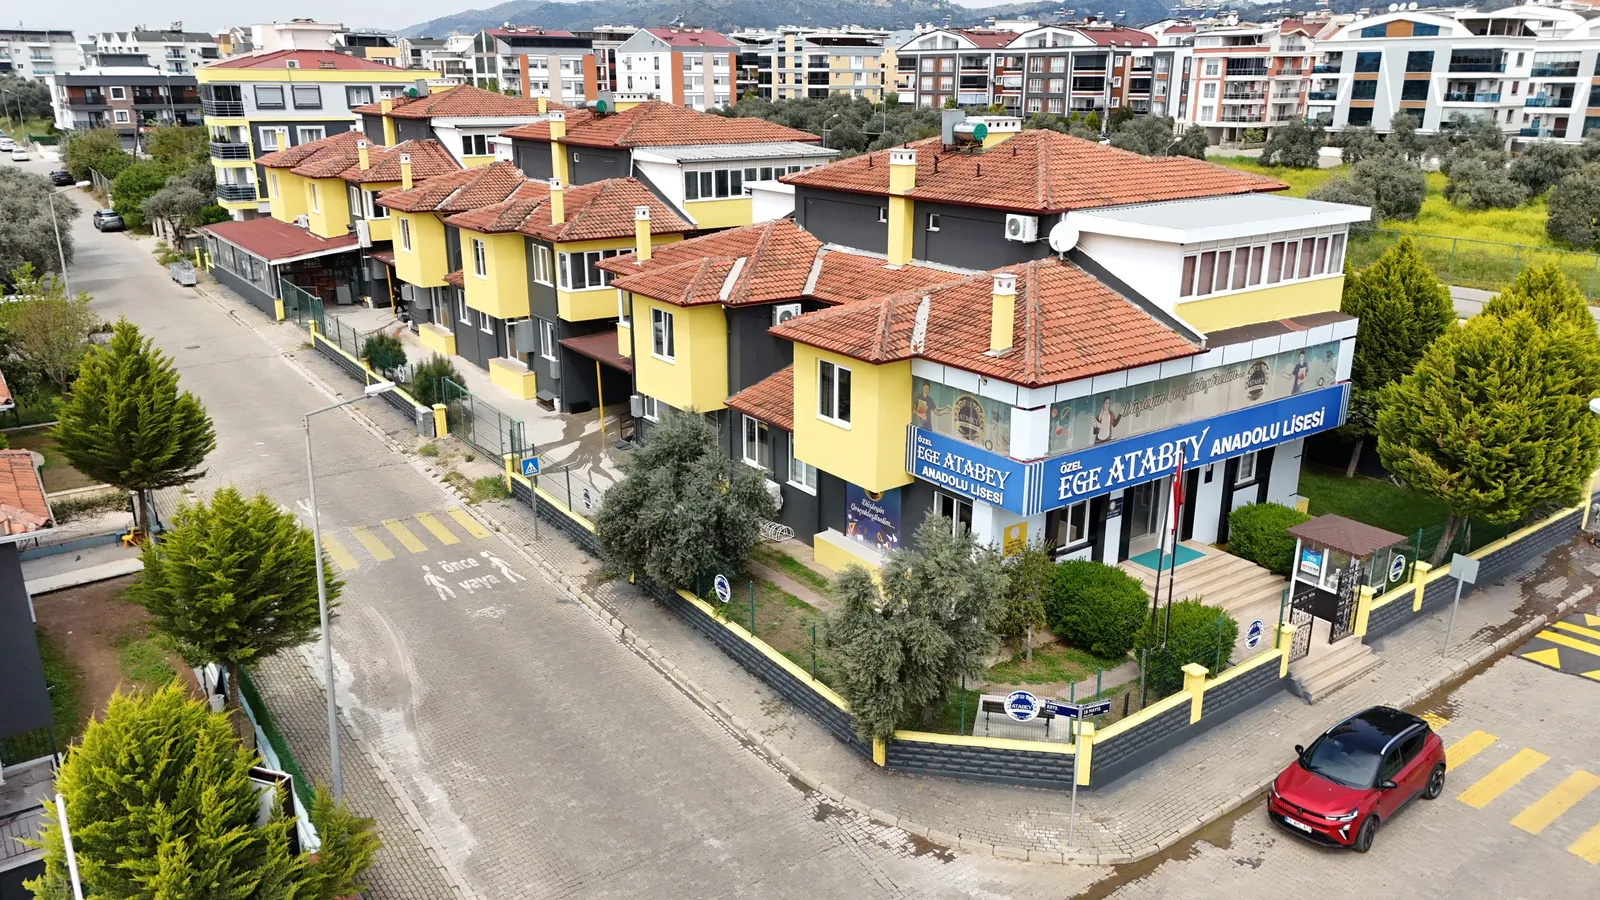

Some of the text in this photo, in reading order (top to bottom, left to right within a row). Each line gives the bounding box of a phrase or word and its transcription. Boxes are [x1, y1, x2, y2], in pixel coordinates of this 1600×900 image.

[1120, 391, 1166, 417] Düşleyin
[917, 434, 933, 447] ÖZEL
[1058, 406, 1325, 500] EGE ATABEY ANADOLU LİSESİ
[917, 445, 1011, 489] EGE ATABEY
[1060, 460, 1083, 475] ÖZEL
[922, 465, 1003, 505] ANADOLU LİSESİ
[438, 558, 480, 573] önce
[458, 574, 501, 594] yaya
